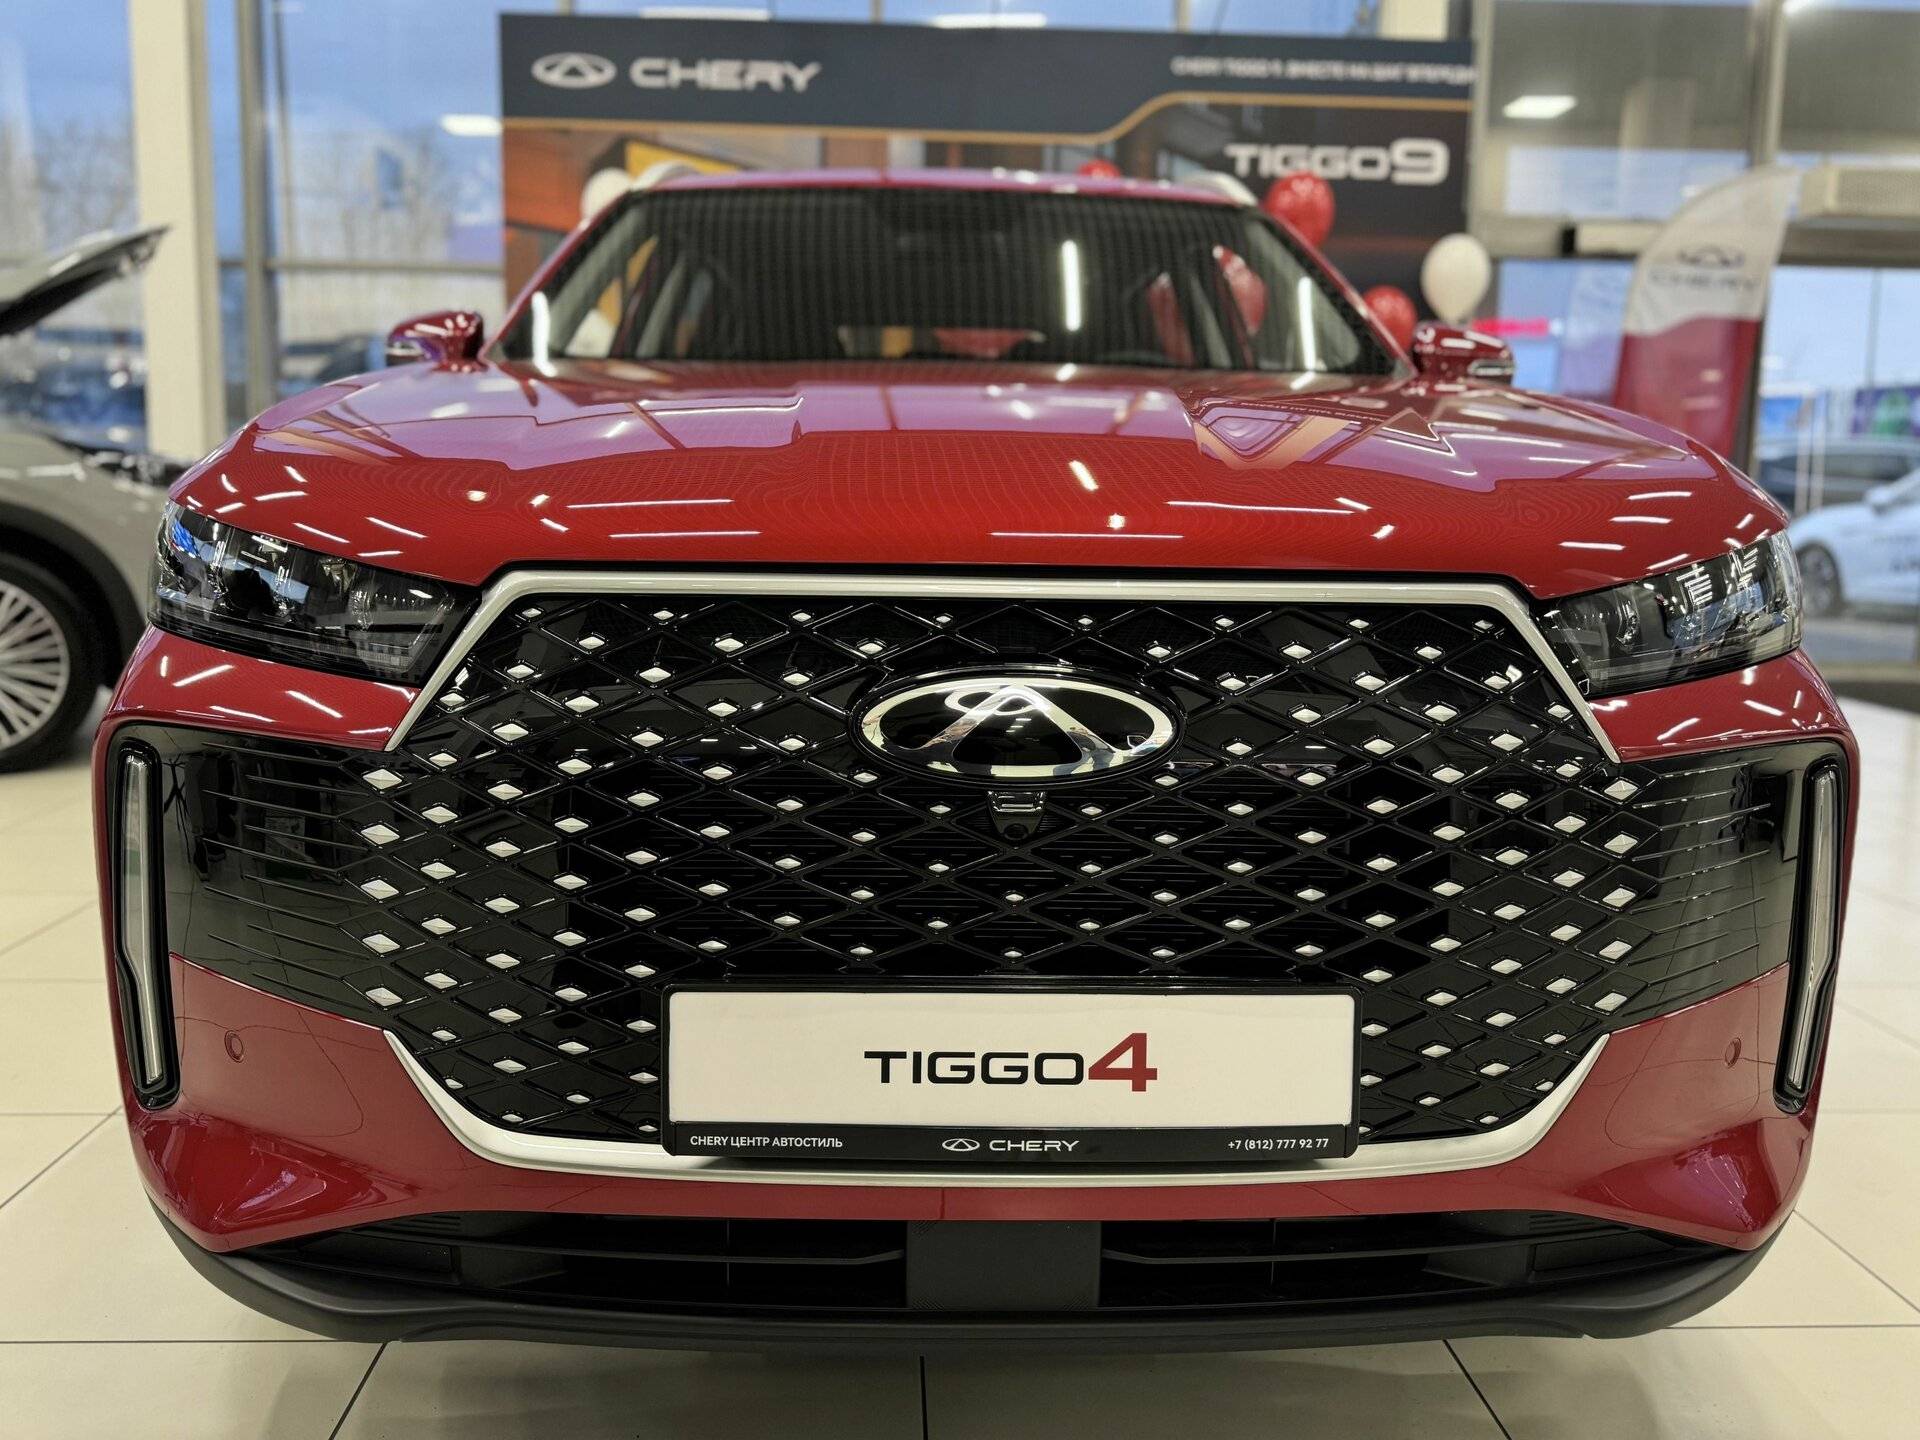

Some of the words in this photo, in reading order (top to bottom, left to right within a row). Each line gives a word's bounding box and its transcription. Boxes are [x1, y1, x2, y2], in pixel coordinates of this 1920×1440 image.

[629, 57, 821, 92] CHERY
[690, 1135, 729, 1146] CHERY
[730, 1136, 770, 1149] ЦЕНТР
[772, 1136, 843, 1148] АВТОСТИЛЬ
[989, 1139, 1080, 1152] CHERY
[1227, 1139, 1242, 1150] +7
[1244, 1138, 1274, 1151] (812)
[1276, 1138, 1297, 1150] 777
[1299, 1138, 1313, 1149] 92
[1315, 1138, 1330, 1149] 77
